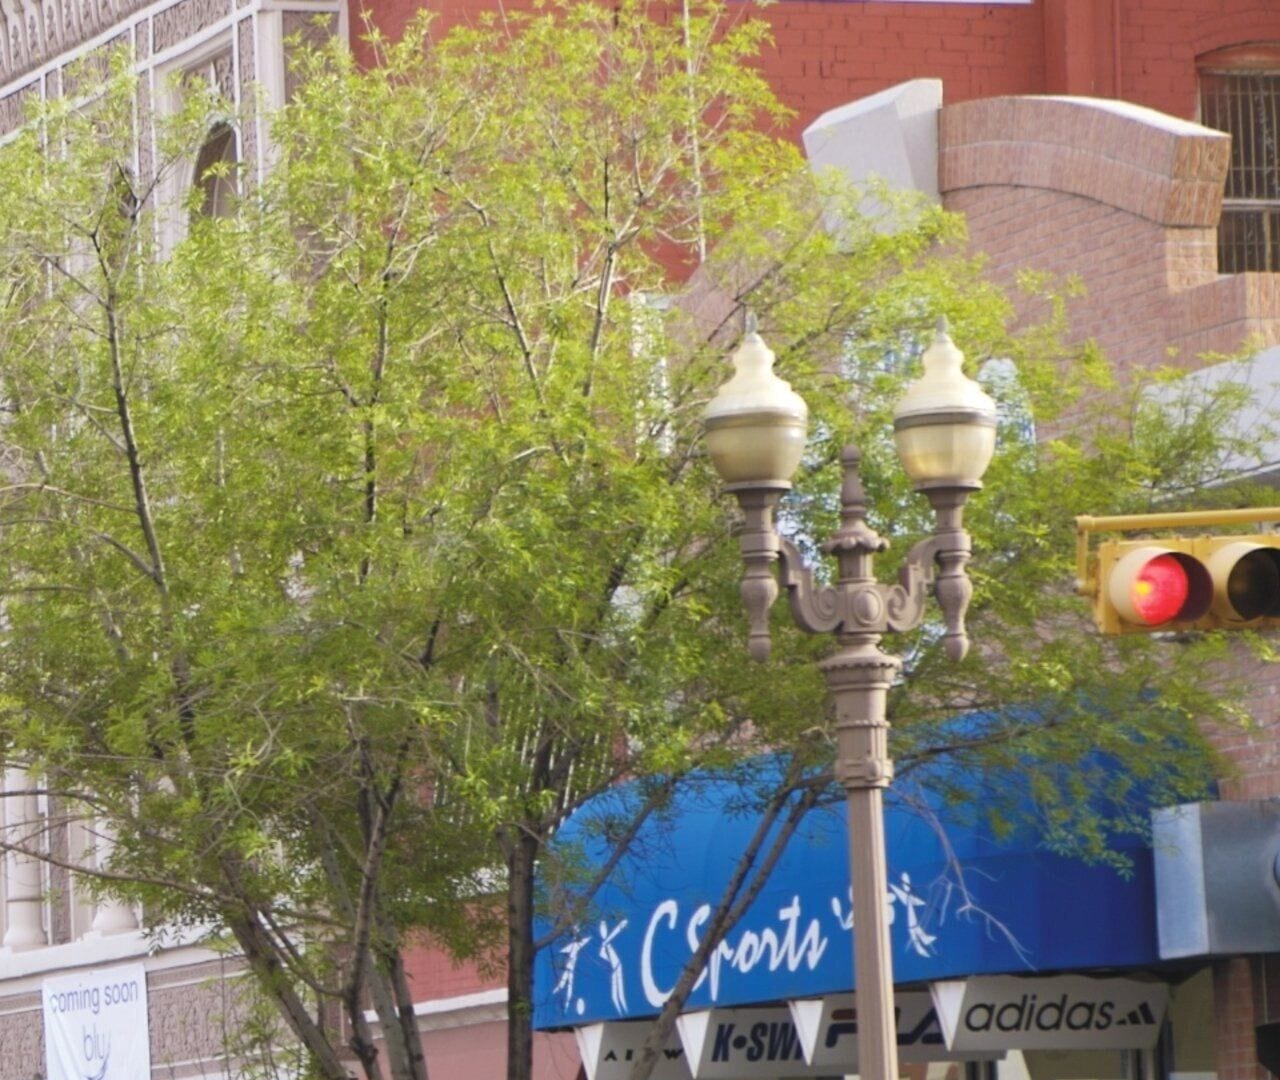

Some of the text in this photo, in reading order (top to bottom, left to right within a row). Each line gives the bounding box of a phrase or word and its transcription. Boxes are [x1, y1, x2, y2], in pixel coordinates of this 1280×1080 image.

[687, 895, 829, 1002] Sports
[49, 979, 139, 1015] coming soon
[965, 993, 1115, 1032] adidas
[82, 1022, 105, 1061] blu
